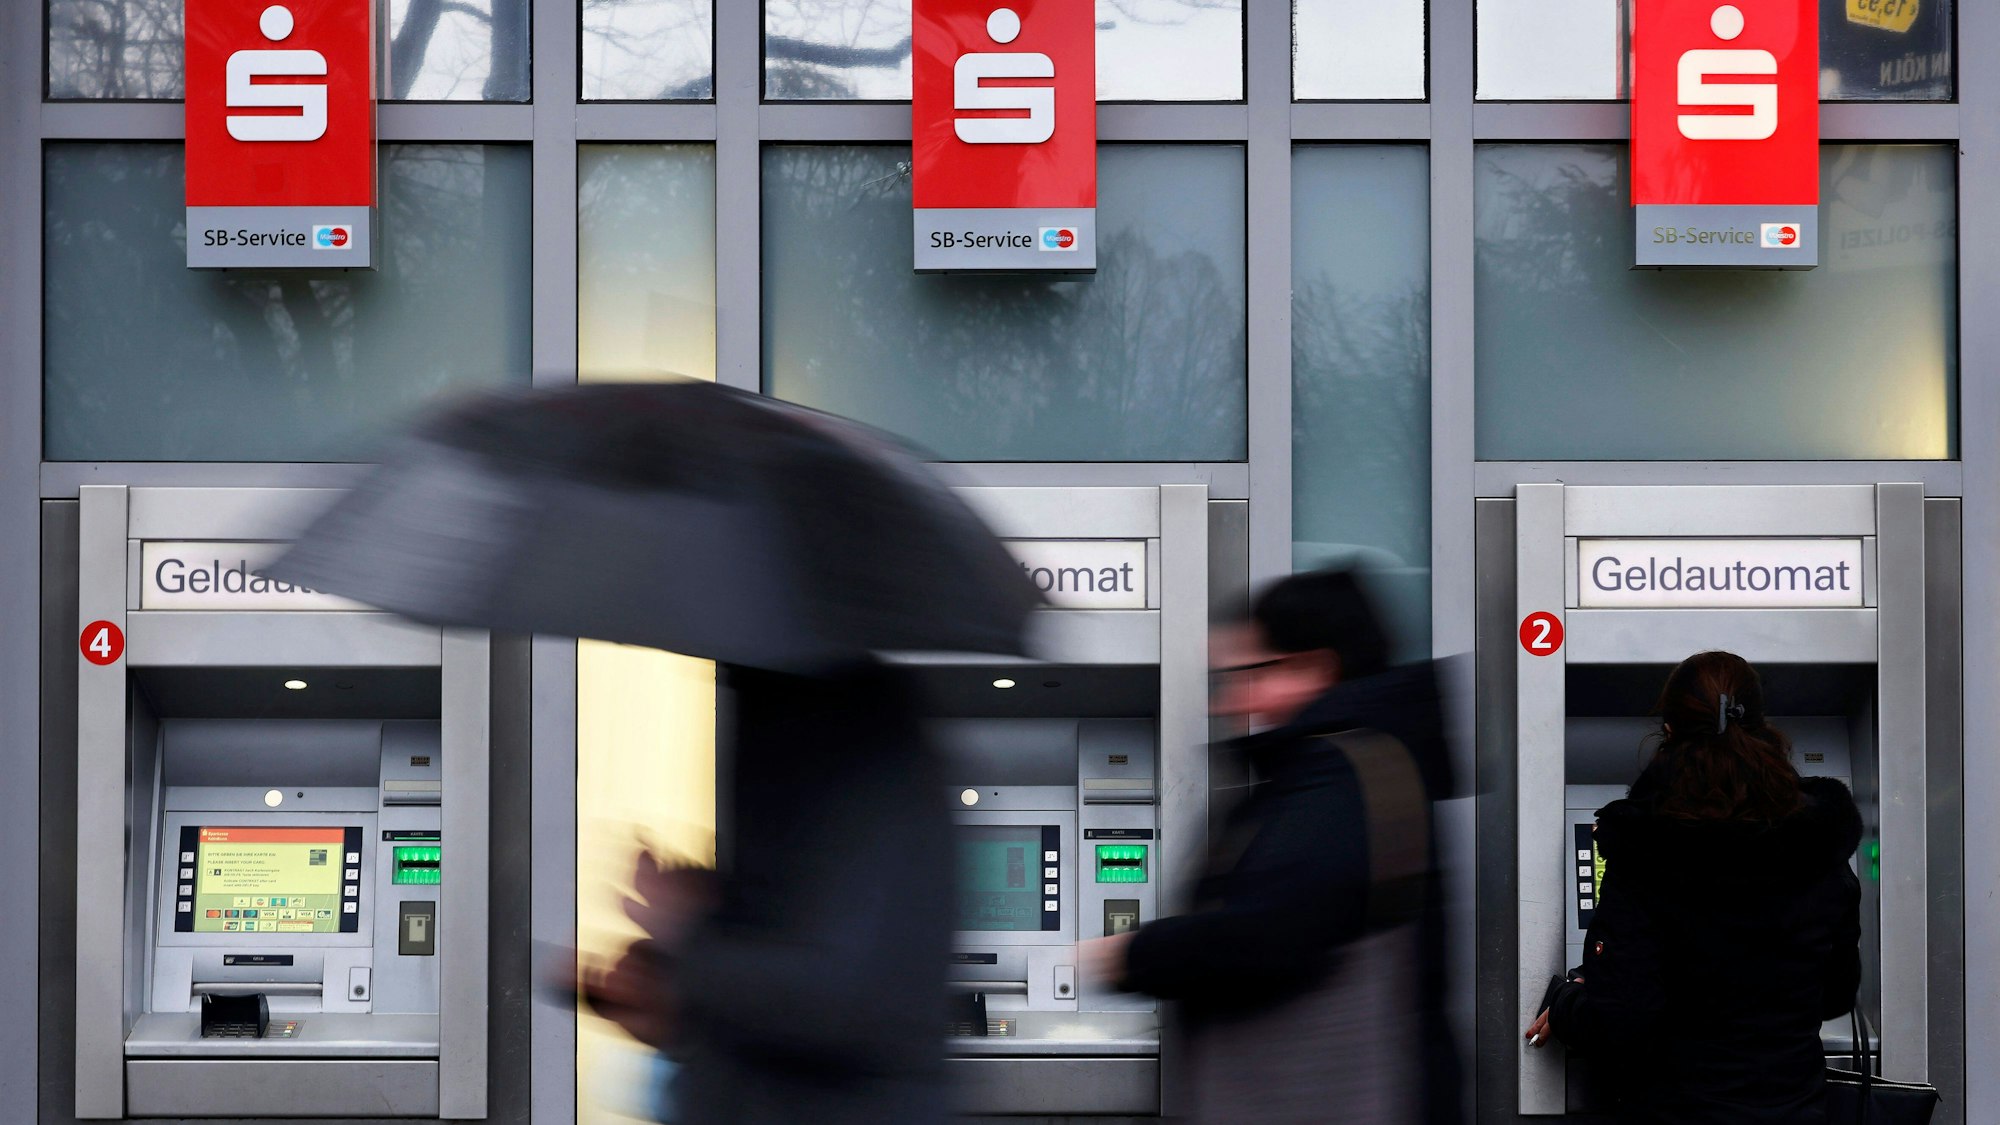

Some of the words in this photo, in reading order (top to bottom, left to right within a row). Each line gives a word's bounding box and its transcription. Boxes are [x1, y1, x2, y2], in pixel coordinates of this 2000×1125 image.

[204, 229, 306, 247] SB-Service
[319, 232, 347, 241] Maestro
[930, 230, 1032, 248] SB-Service
[1652, 226, 1755, 244] SB-Service
[155, 558, 331, 595] Geldau
[1592, 556, 1851, 592] Geldautomat
[89, 627, 112, 658] 4
[1531, 618, 1552, 649] 2
